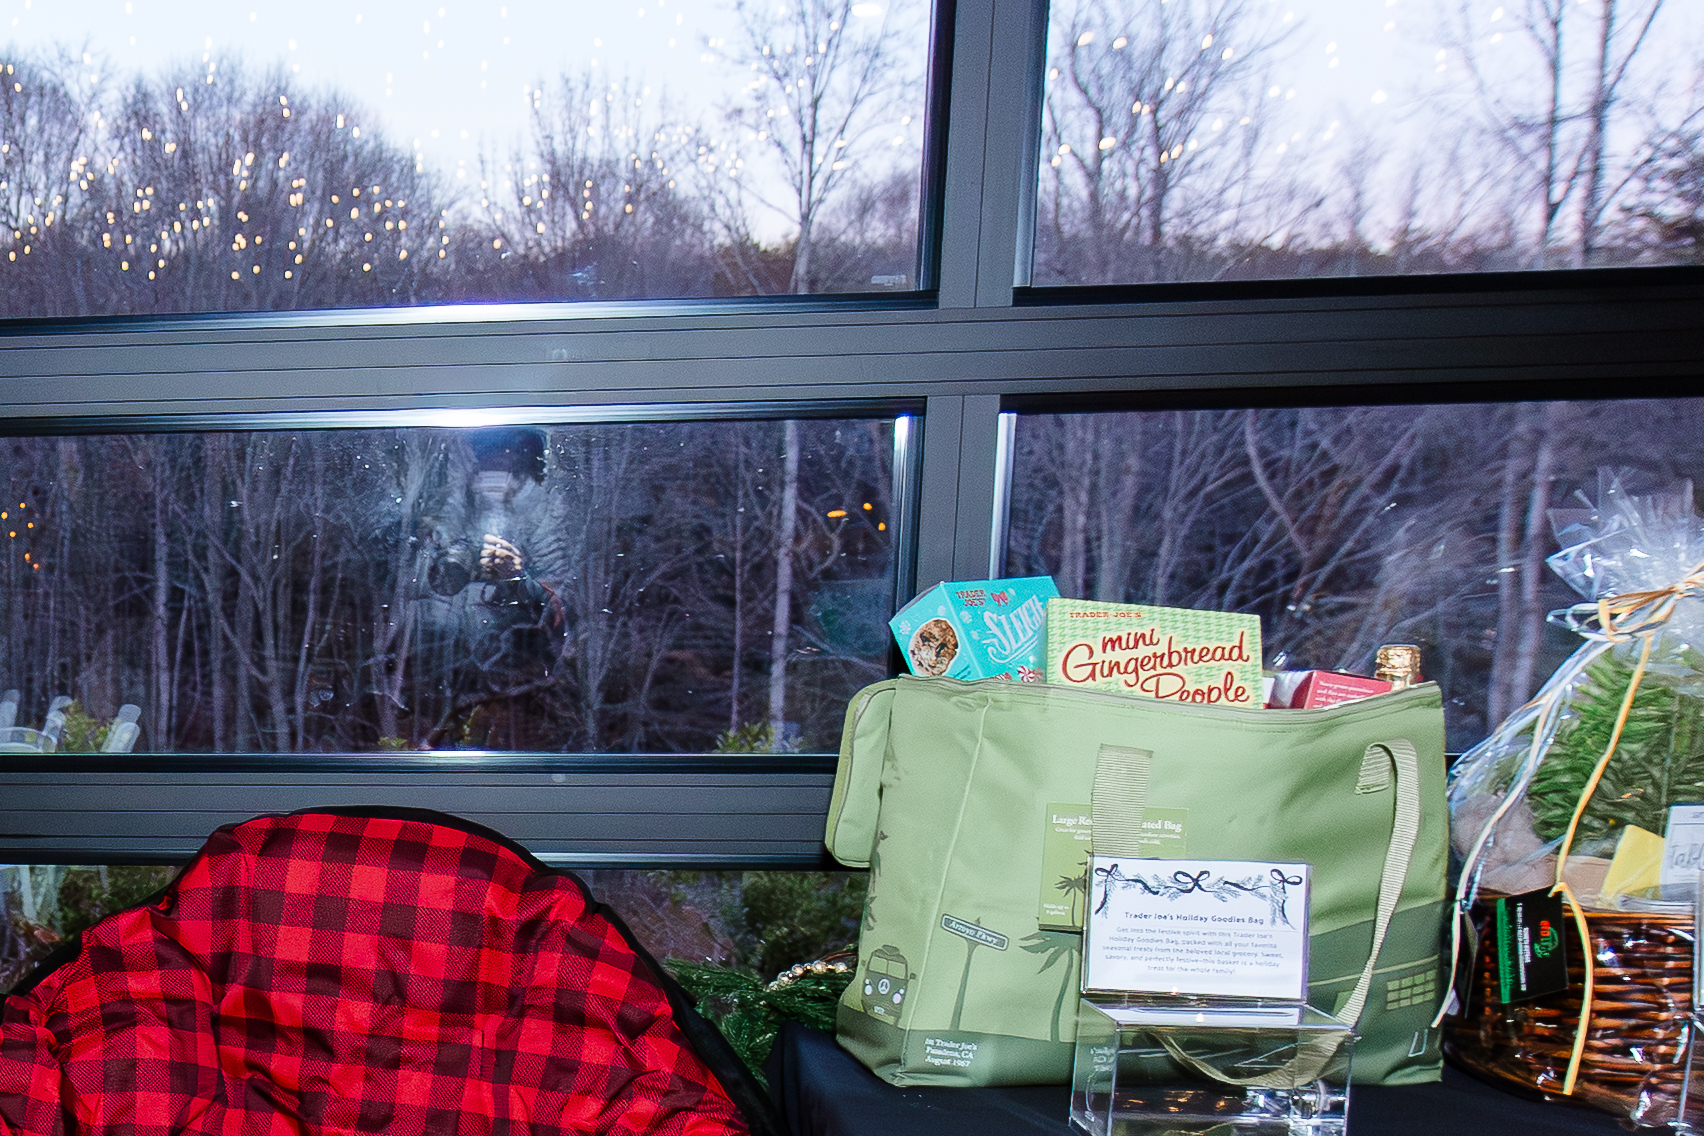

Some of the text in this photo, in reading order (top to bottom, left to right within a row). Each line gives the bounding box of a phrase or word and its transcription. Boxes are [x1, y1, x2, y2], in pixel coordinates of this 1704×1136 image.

[1069, 611, 1110, 619] TRADER
[1101, 627, 1160, 654] mini
[1062, 630, 1250, 688] Gingerbread
[1052, 814, 1078, 827] Large
[1164, 819, 1183, 833] Bag
[1124, 912, 1152, 920] Trader
[1176, 914, 1208, 923] Holiday
[1211, 915, 1246, 924] Goodies
[1248, 916, 1265, 925] Bag
